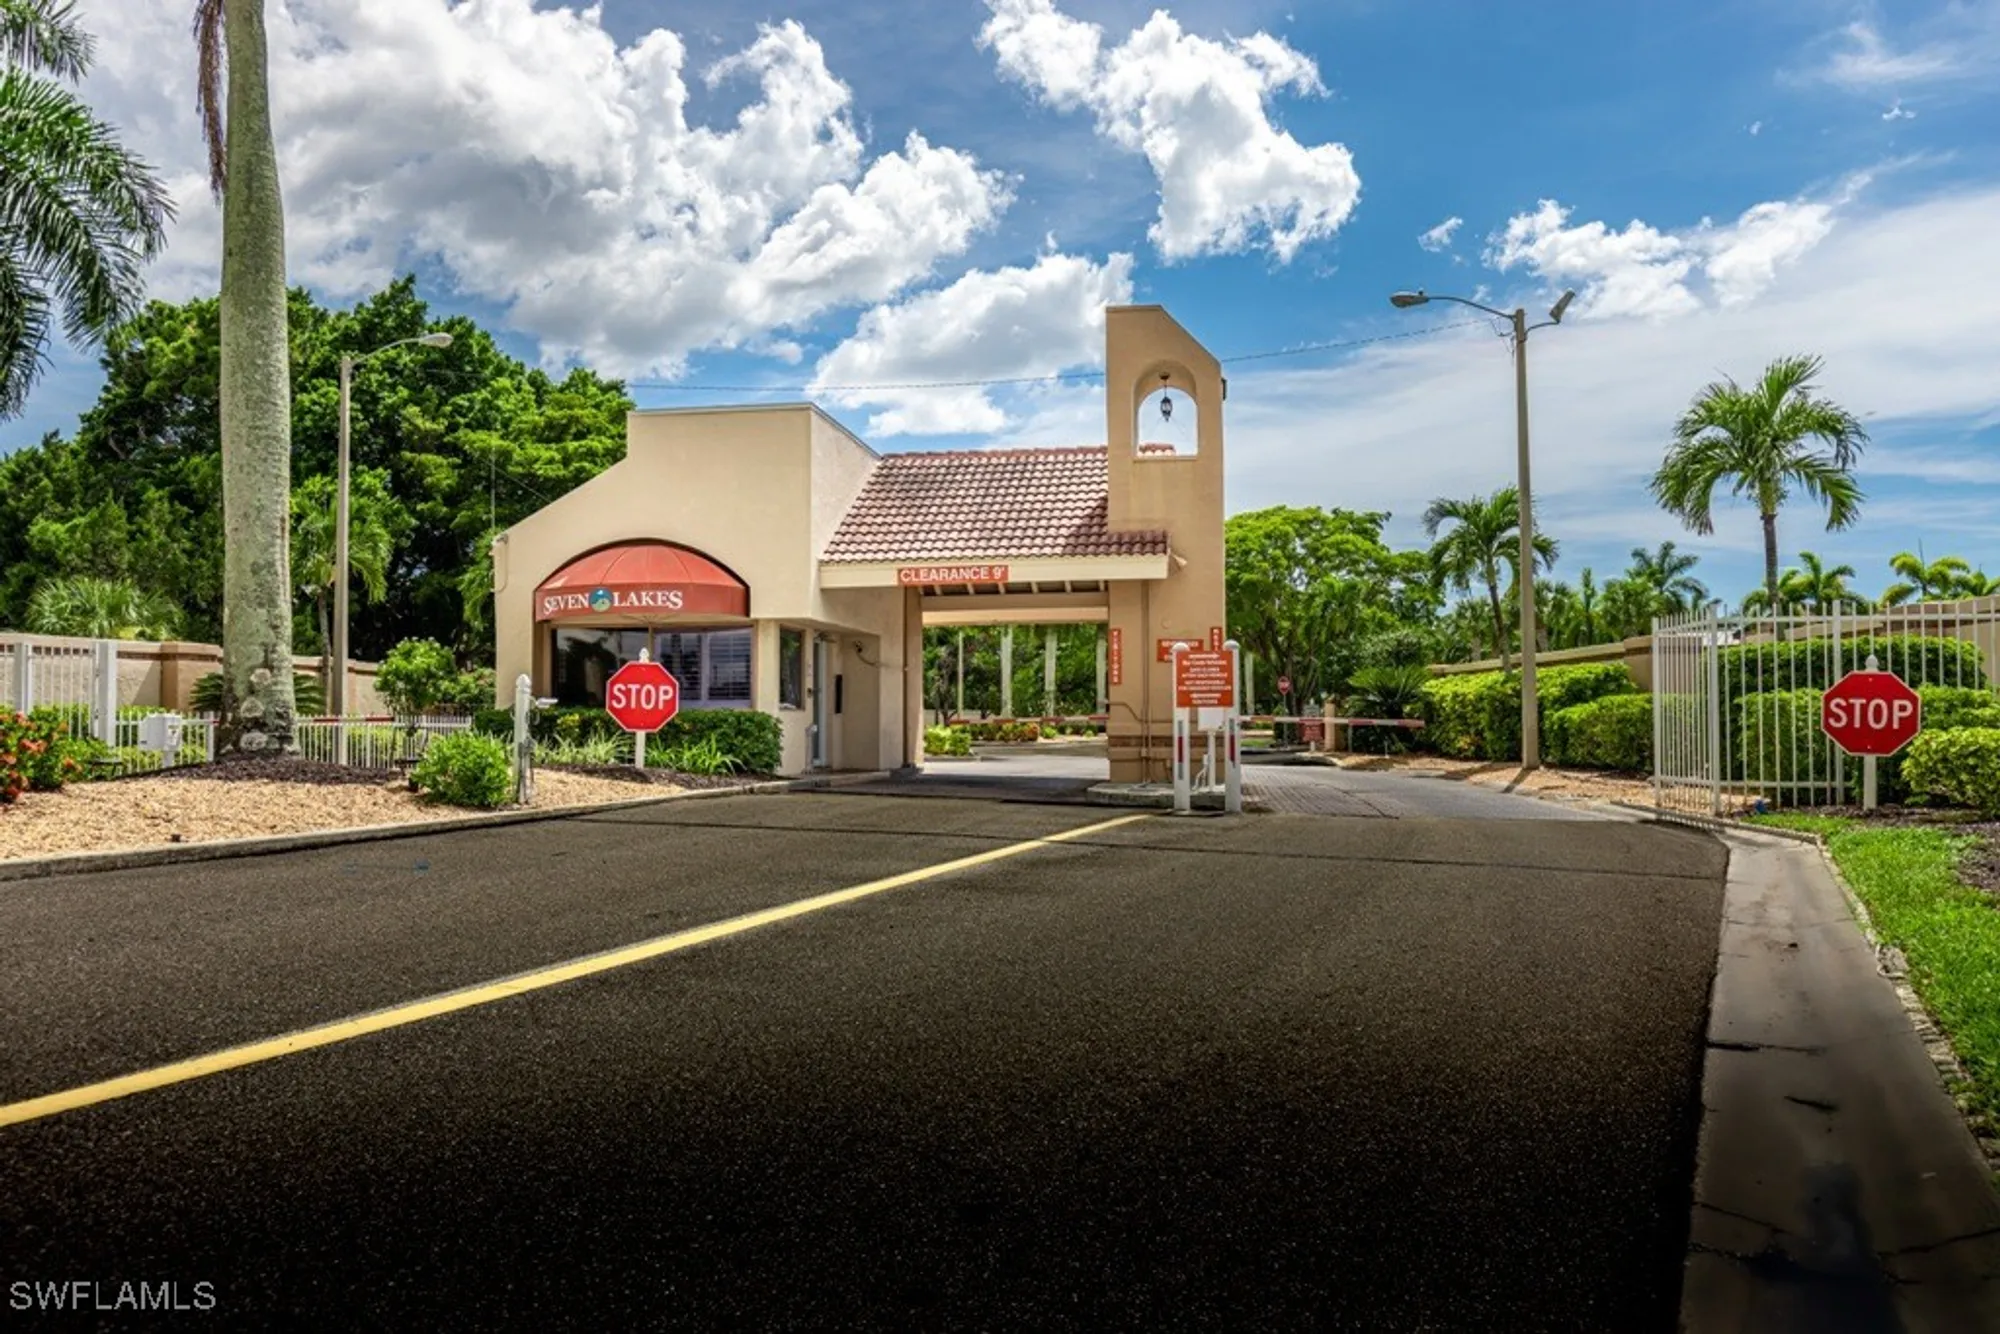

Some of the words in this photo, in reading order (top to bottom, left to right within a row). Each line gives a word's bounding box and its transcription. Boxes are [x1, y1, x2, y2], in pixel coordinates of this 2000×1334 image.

[900, 566, 990, 582] CLEARANCE
[543, 592, 591, 615] SEVEN
[613, 590, 683, 610] LAKES
[611, 683, 674, 710] STOP
[1827, 697, 1914, 730] STOP
